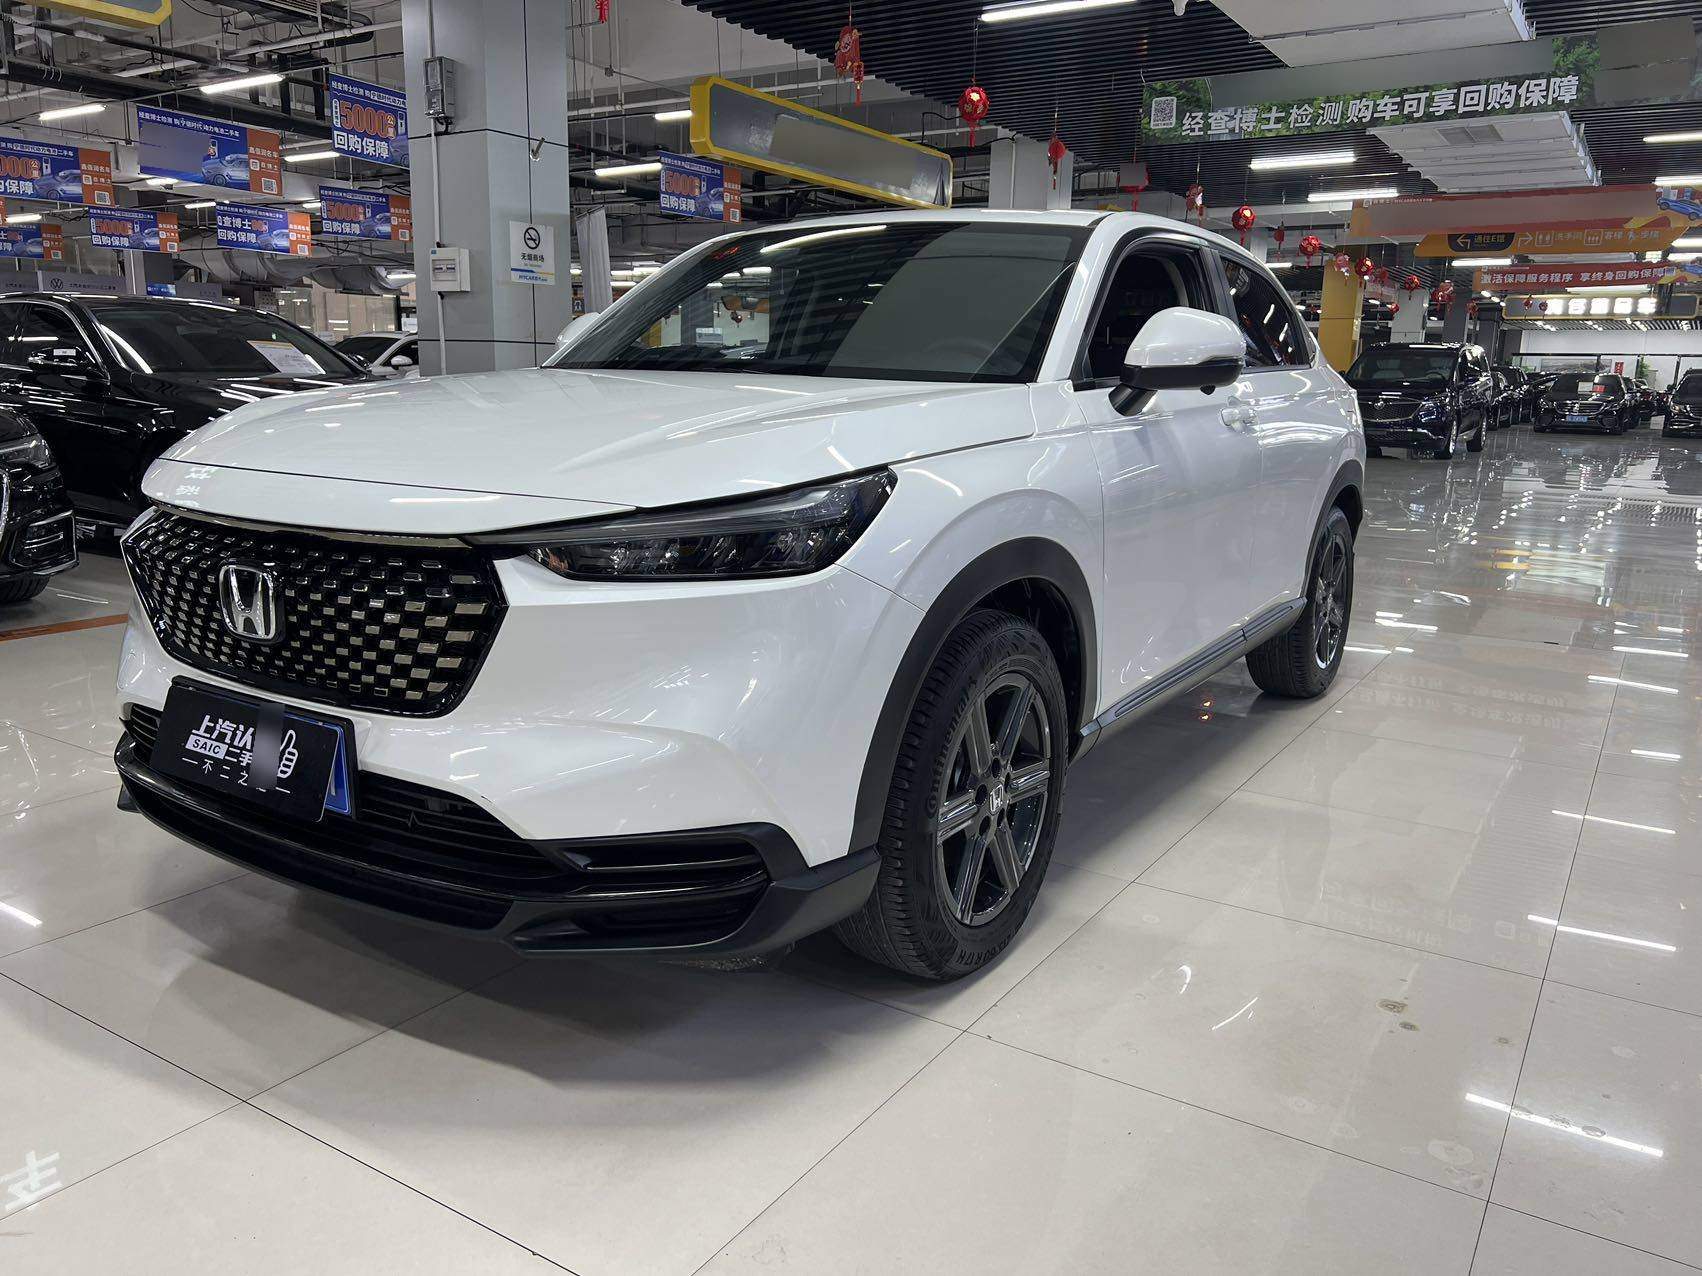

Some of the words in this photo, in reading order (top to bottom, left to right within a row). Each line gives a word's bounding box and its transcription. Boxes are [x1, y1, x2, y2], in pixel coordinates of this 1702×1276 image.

[333, 131, 389, 159] 回购保障
[661, 193, 696, 212] 回购保障
[217, 228, 257, 243] 回购保障
[322, 220, 360, 235] 回购保障
[92, 234, 129, 247] 回购保障
[1481, 272, 1573, 285] 激活保障服务程序
[1580, 268, 1665, 282] 享终身回购保障
[192, 739, 221, 755] SAIC
